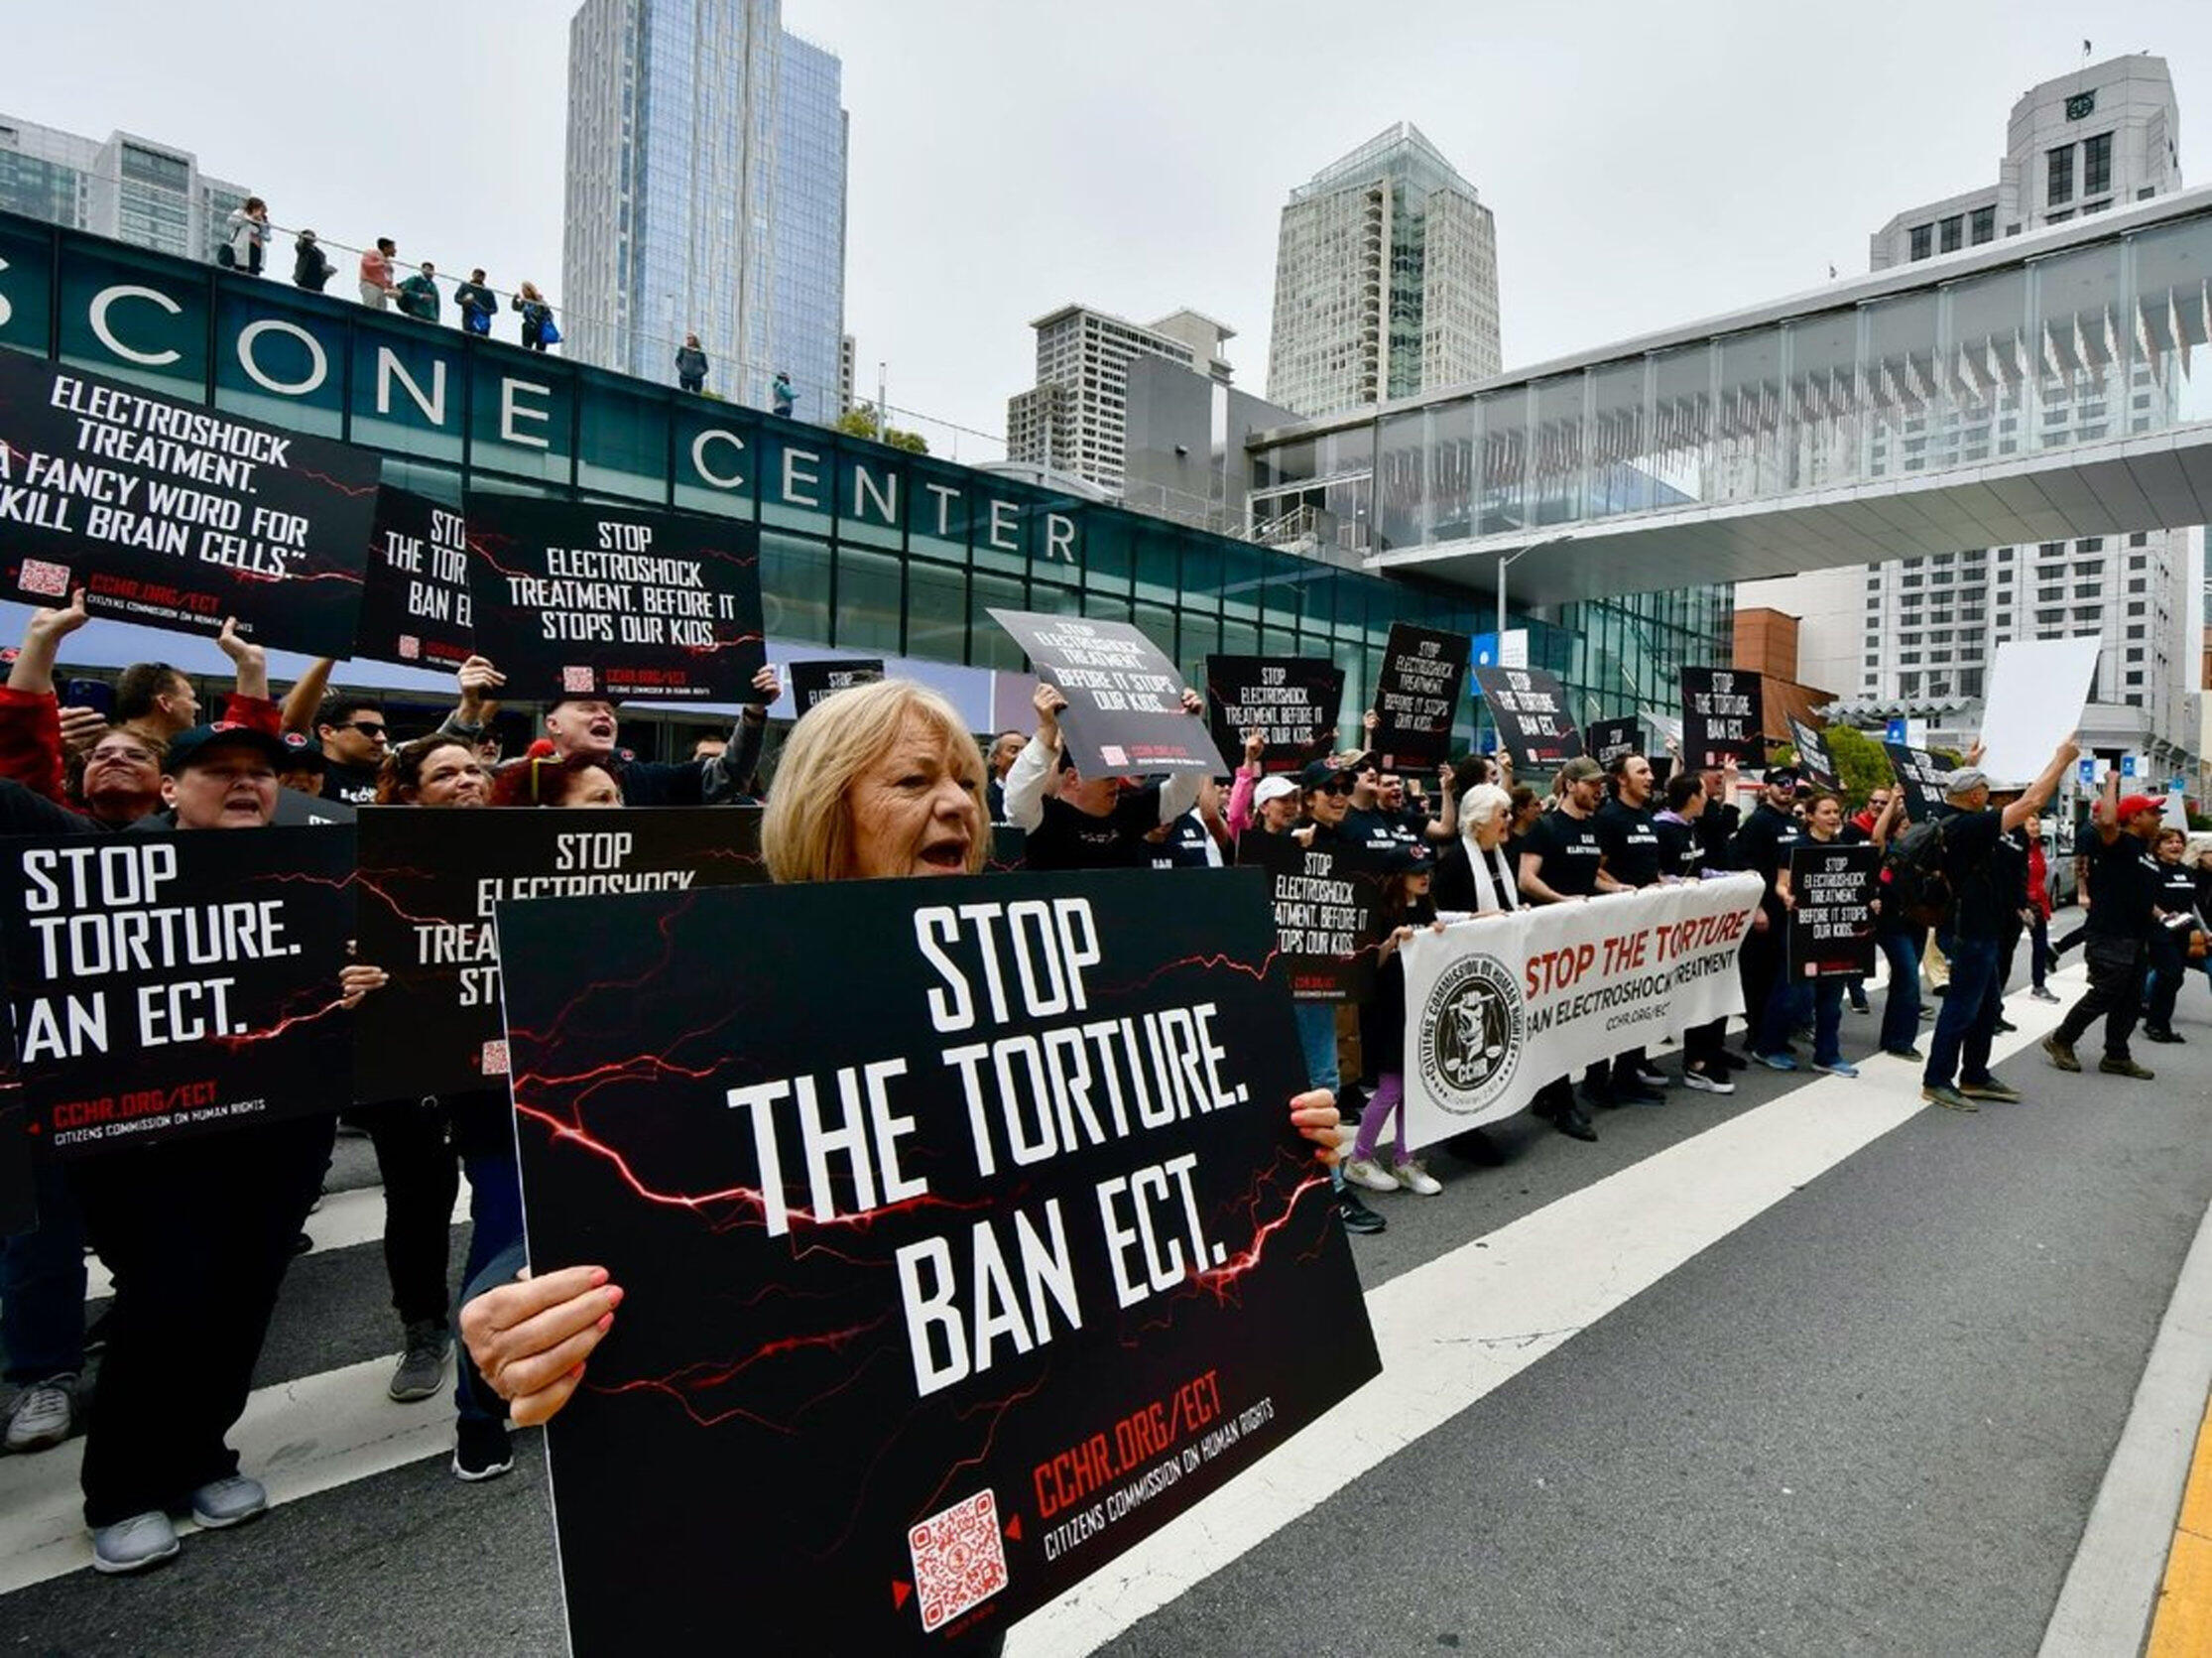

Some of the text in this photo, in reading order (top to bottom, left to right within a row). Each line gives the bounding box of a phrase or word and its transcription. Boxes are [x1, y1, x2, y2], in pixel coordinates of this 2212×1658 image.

[0, 253, 1076, 564] CONE CENTER
[51, 375, 293, 468] ELECTROSHOCK
[77, 418, 257, 494] TREATMENT.
[26, 451, 139, 505] FANCY
[149, 481, 241, 532] WORD
[251, 506, 308, 548] FOR
[85, 504, 188, 557] BRAIN
[598, 521, 652, 553] STOP
[385, 530, 425, 574] THE
[547, 548, 704, 588] ELECTROSHOCK
[408, 580, 450, 621] BAN
[506, 576, 735, 620] TREATMENT. BEFORE IT
[542, 611, 614, 642] STOPS
[620, 615, 664, 645] OUR
[1417, 640, 1442, 659] STOP
[1054, 667, 1178, 696] BEFORE IT STOPS
[1240, 687, 1309, 704] ELECTROSHOCK
[1261, 667, 1287, 686] STOP
[1712, 672, 1734, 694] STOP
[1091, 690, 1129, 710] OUR
[1281, 706, 1313, 725] BEFORE
[1271, 726, 1291, 744] OUR
[1706, 718, 1725, 740] BAN
[555, 831, 633, 870] STOP
[1304, 851, 1333, 876] STOP
[1824, 856, 1849, 873] STOP
[23, 843, 178, 912] STOP
[1276, 874, 1355, 906] ELECTROSHOCK
[1802, 871, 1868, 890] ELECTROSHOCK
[1271, 901, 1368, 932] ATMENT. BEFORE IT
[1798, 907, 1828, 925] BEFORE
[1841, 905, 1868, 923] STOPS
[1813, 924, 1832, 940] OUR
[30, 900, 302, 980] TORTURE.
[1306, 931, 1329, 956] OUR
[1526, 910, 1752, 1001] STOP THE TORTURE
[914, 896, 1101, 1033] STOP
[11, 977, 248, 1064] AN ECT.
[54, 1079, 219, 1129] CCHR.ORG/ECT
[55, 1098, 267, 1146] CITIZENS COMMISSION ON HUMAN RIGHTS
[727, 1002, 1250, 1238] THE TORTURE.
[896, 1153, 1229, 1398] BAN ECT.
[1033, 1369, 1222, 1519] CCHR.ORG/ECT
[1044, 1395, 1276, 1563] CITIZENS COMMISSION ON HUMAN RIGHTS
